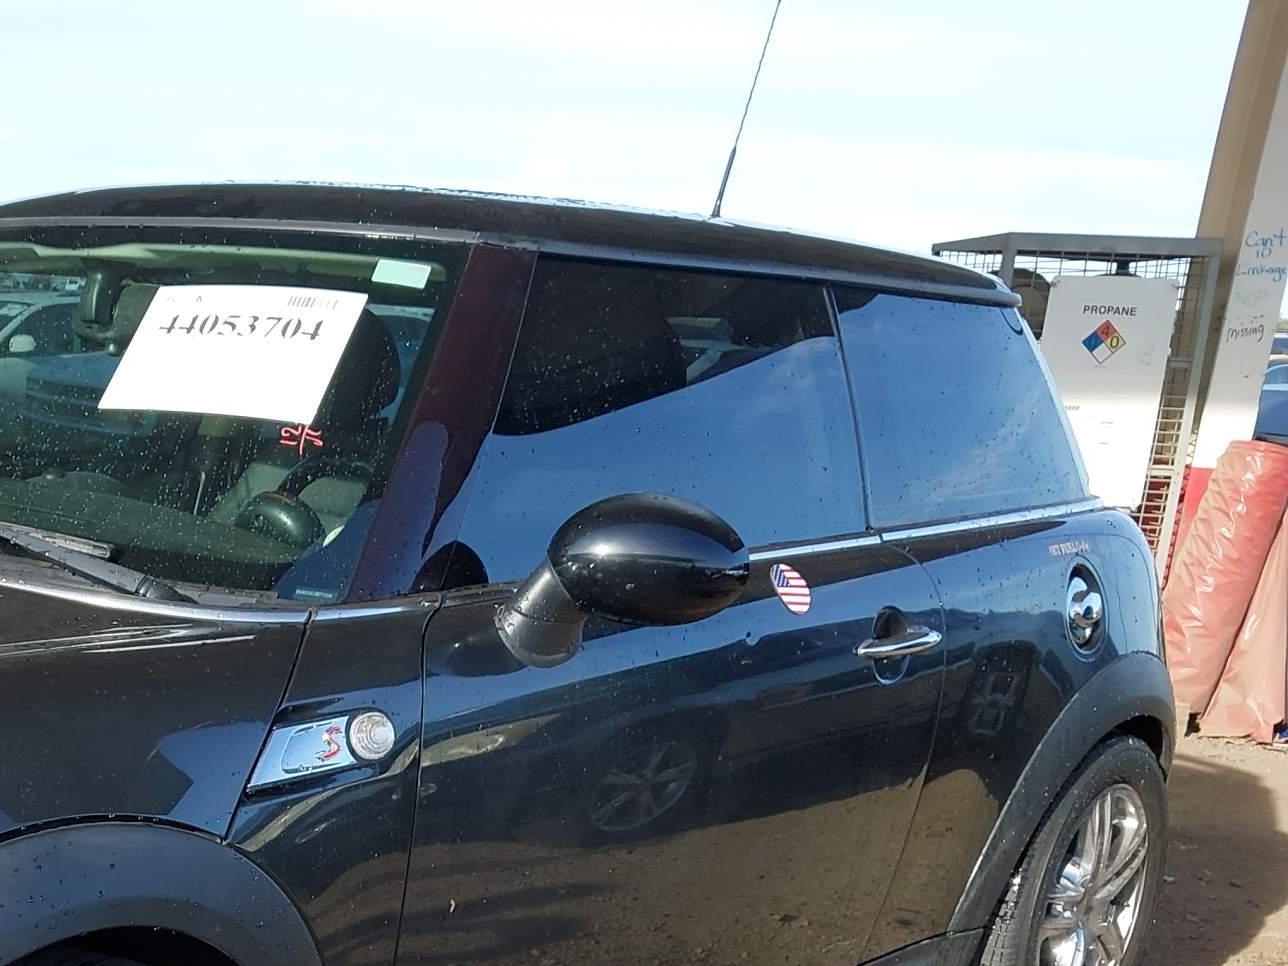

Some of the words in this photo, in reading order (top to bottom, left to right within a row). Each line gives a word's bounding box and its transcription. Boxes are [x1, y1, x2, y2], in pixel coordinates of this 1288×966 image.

[1082, 304, 1137, 316] PROPANE
[159, 313, 324, 341] 44053704
[1101, 325, 1110, 337] 4
[1226, 324, 1264, 342] missing
[1109, 335, 1120, 349] 0
[315, 726, 342, 761] S
